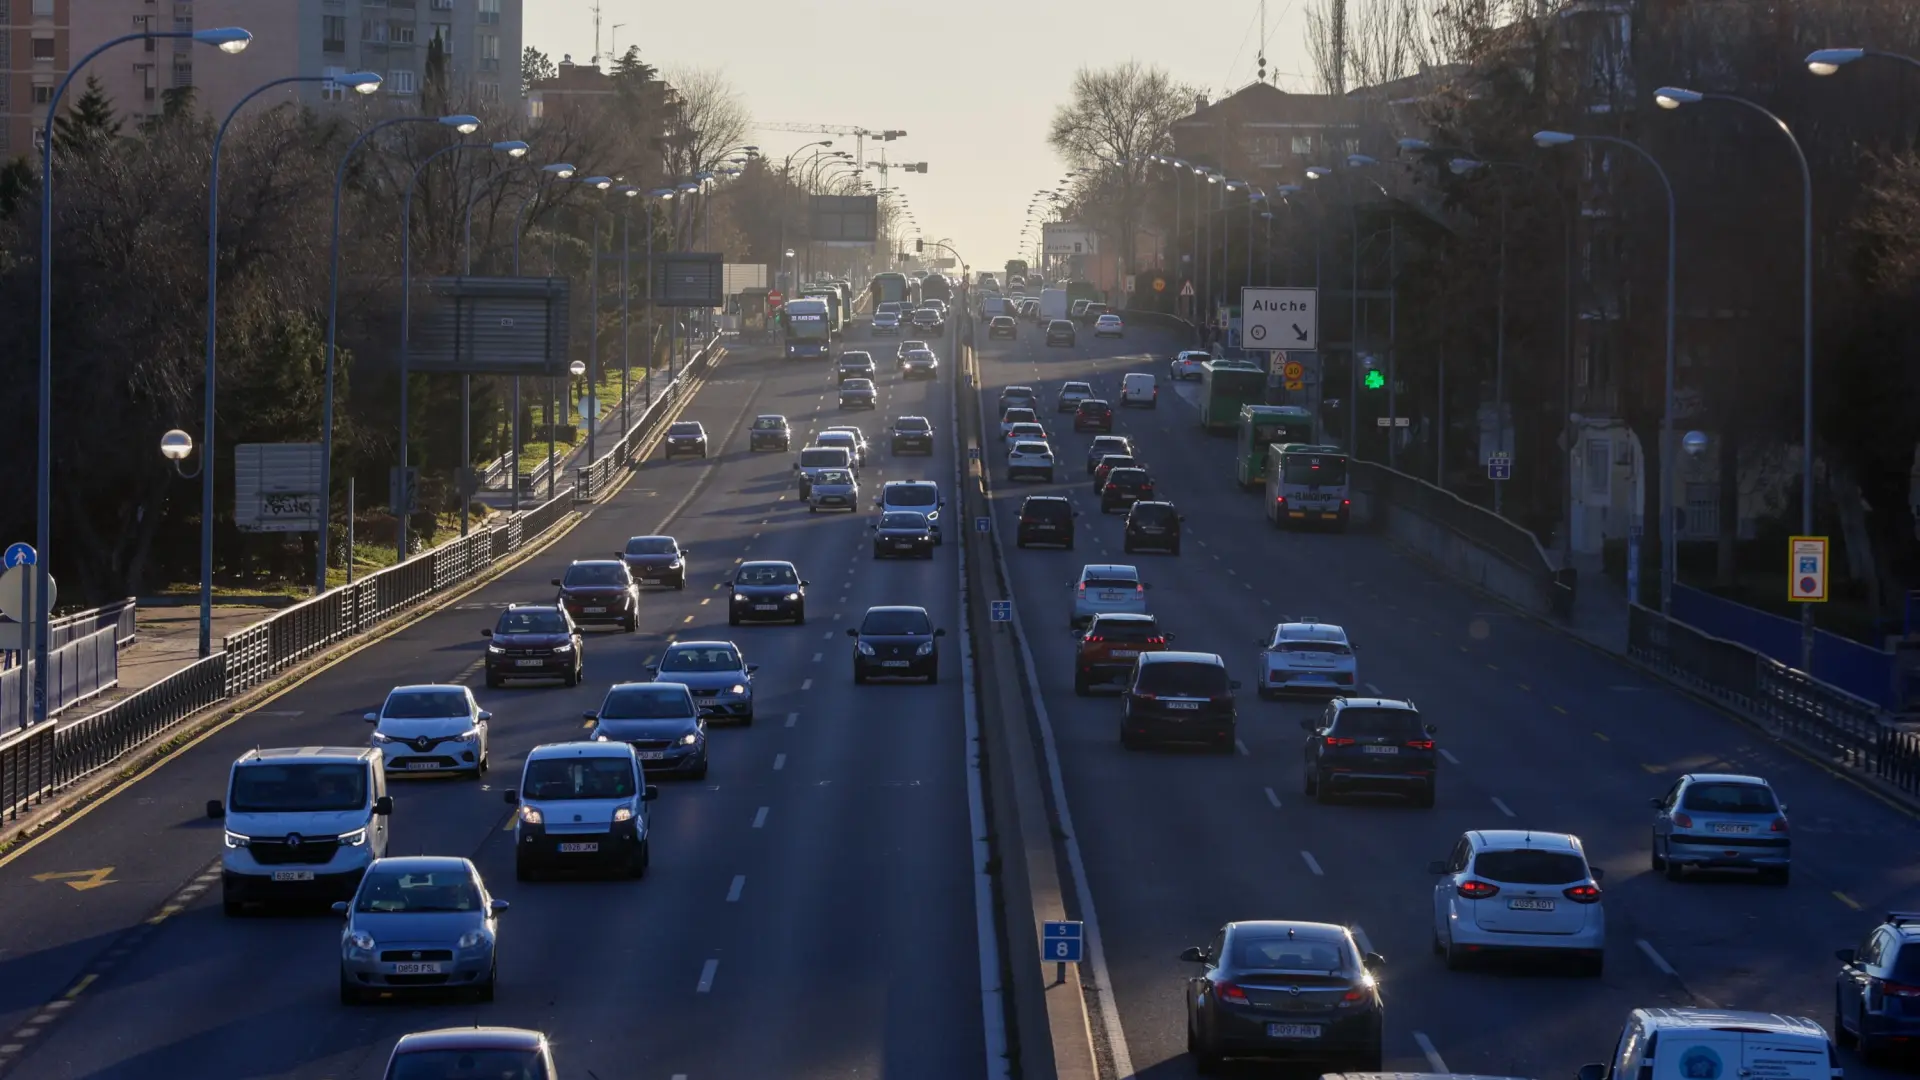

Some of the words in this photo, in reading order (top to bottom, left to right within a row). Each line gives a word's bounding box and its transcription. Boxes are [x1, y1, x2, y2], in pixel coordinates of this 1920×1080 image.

[1252, 299, 1306, 312] Aluche
[1288, 367, 1299, 375] 30
[998, 611, 1005, 620] 9
[1059, 925, 1067, 935] 5
[1056, 941, 1068, 957] 8
[398, 963, 419, 973] 0859
[1274, 1024, 1297, 1035] 5097
[1300, 1025, 1317, 1036] HRV
